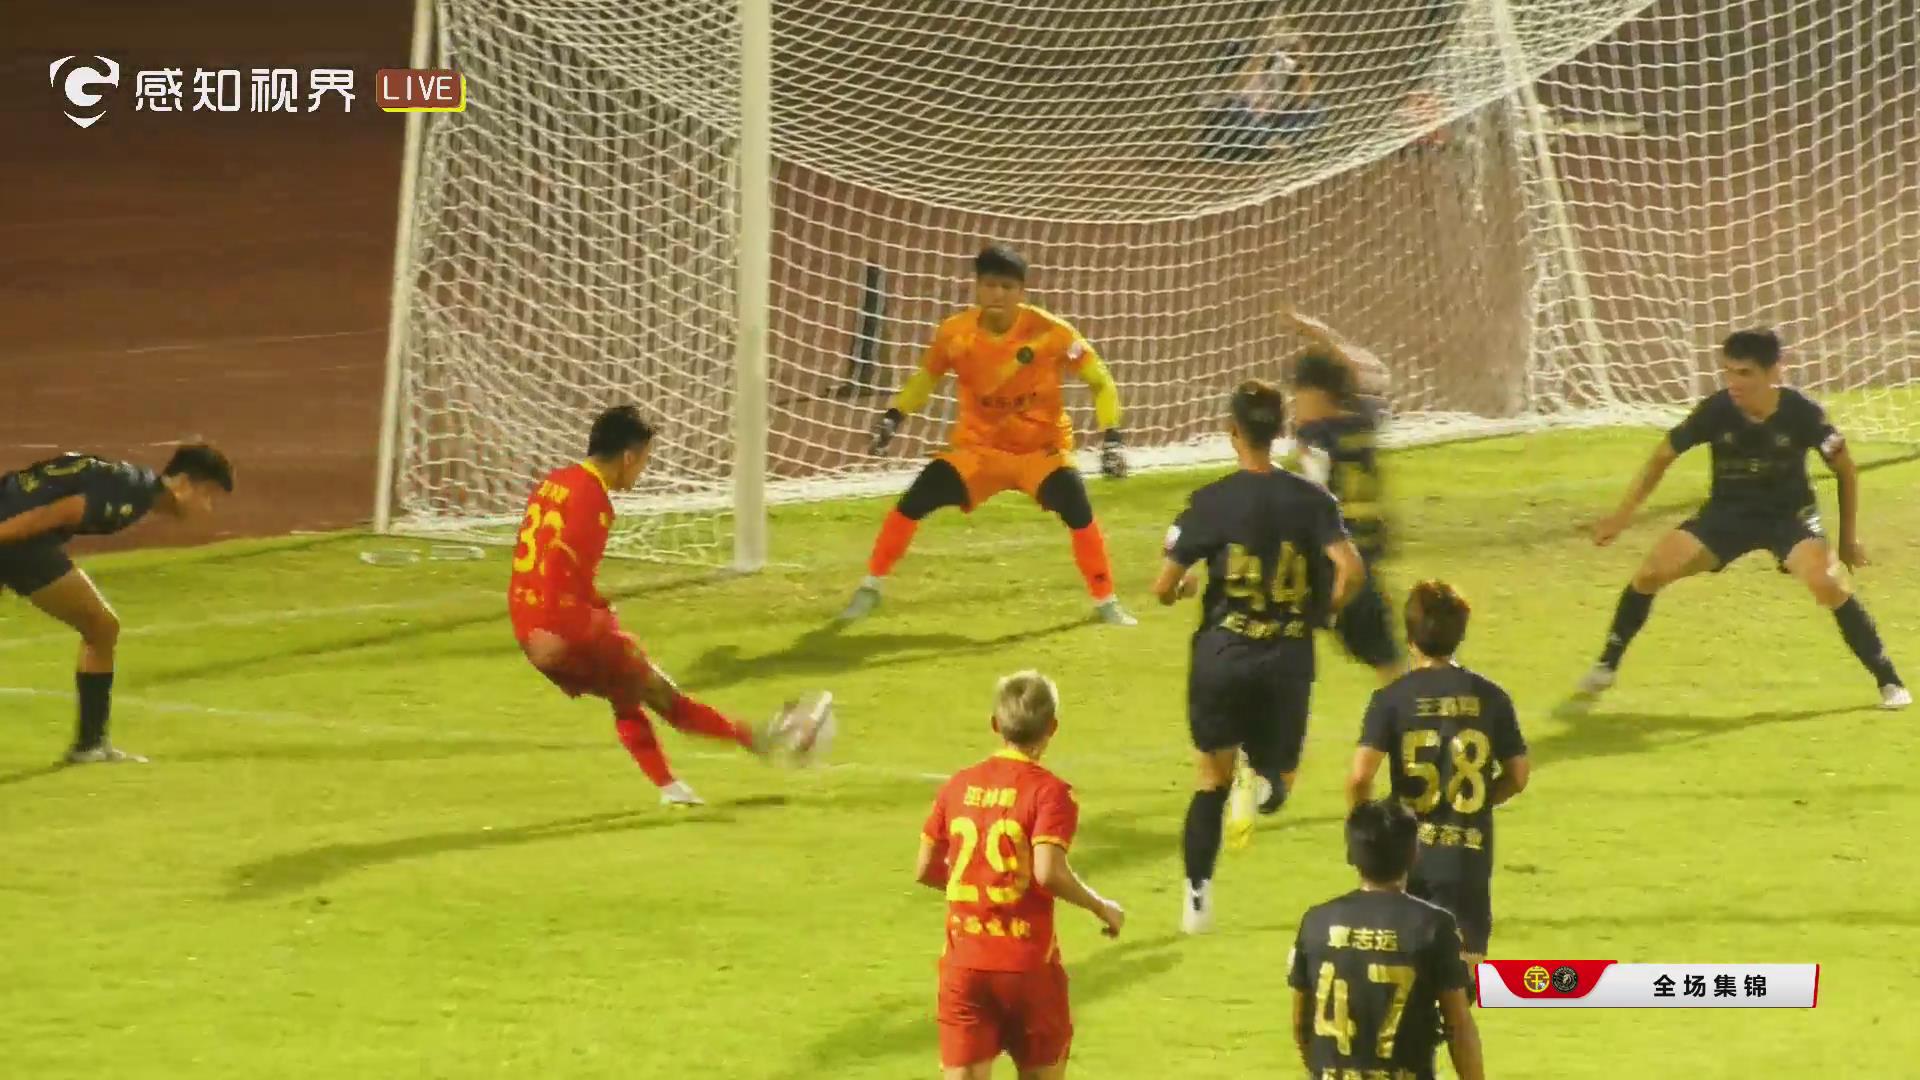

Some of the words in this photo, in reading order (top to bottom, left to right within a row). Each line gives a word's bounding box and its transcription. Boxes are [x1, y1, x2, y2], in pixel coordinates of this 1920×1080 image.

[1401, 727, 1491, 816] 58
[946, 816, 1032, 905] 29
[1314, 960, 1416, 1059] 47
